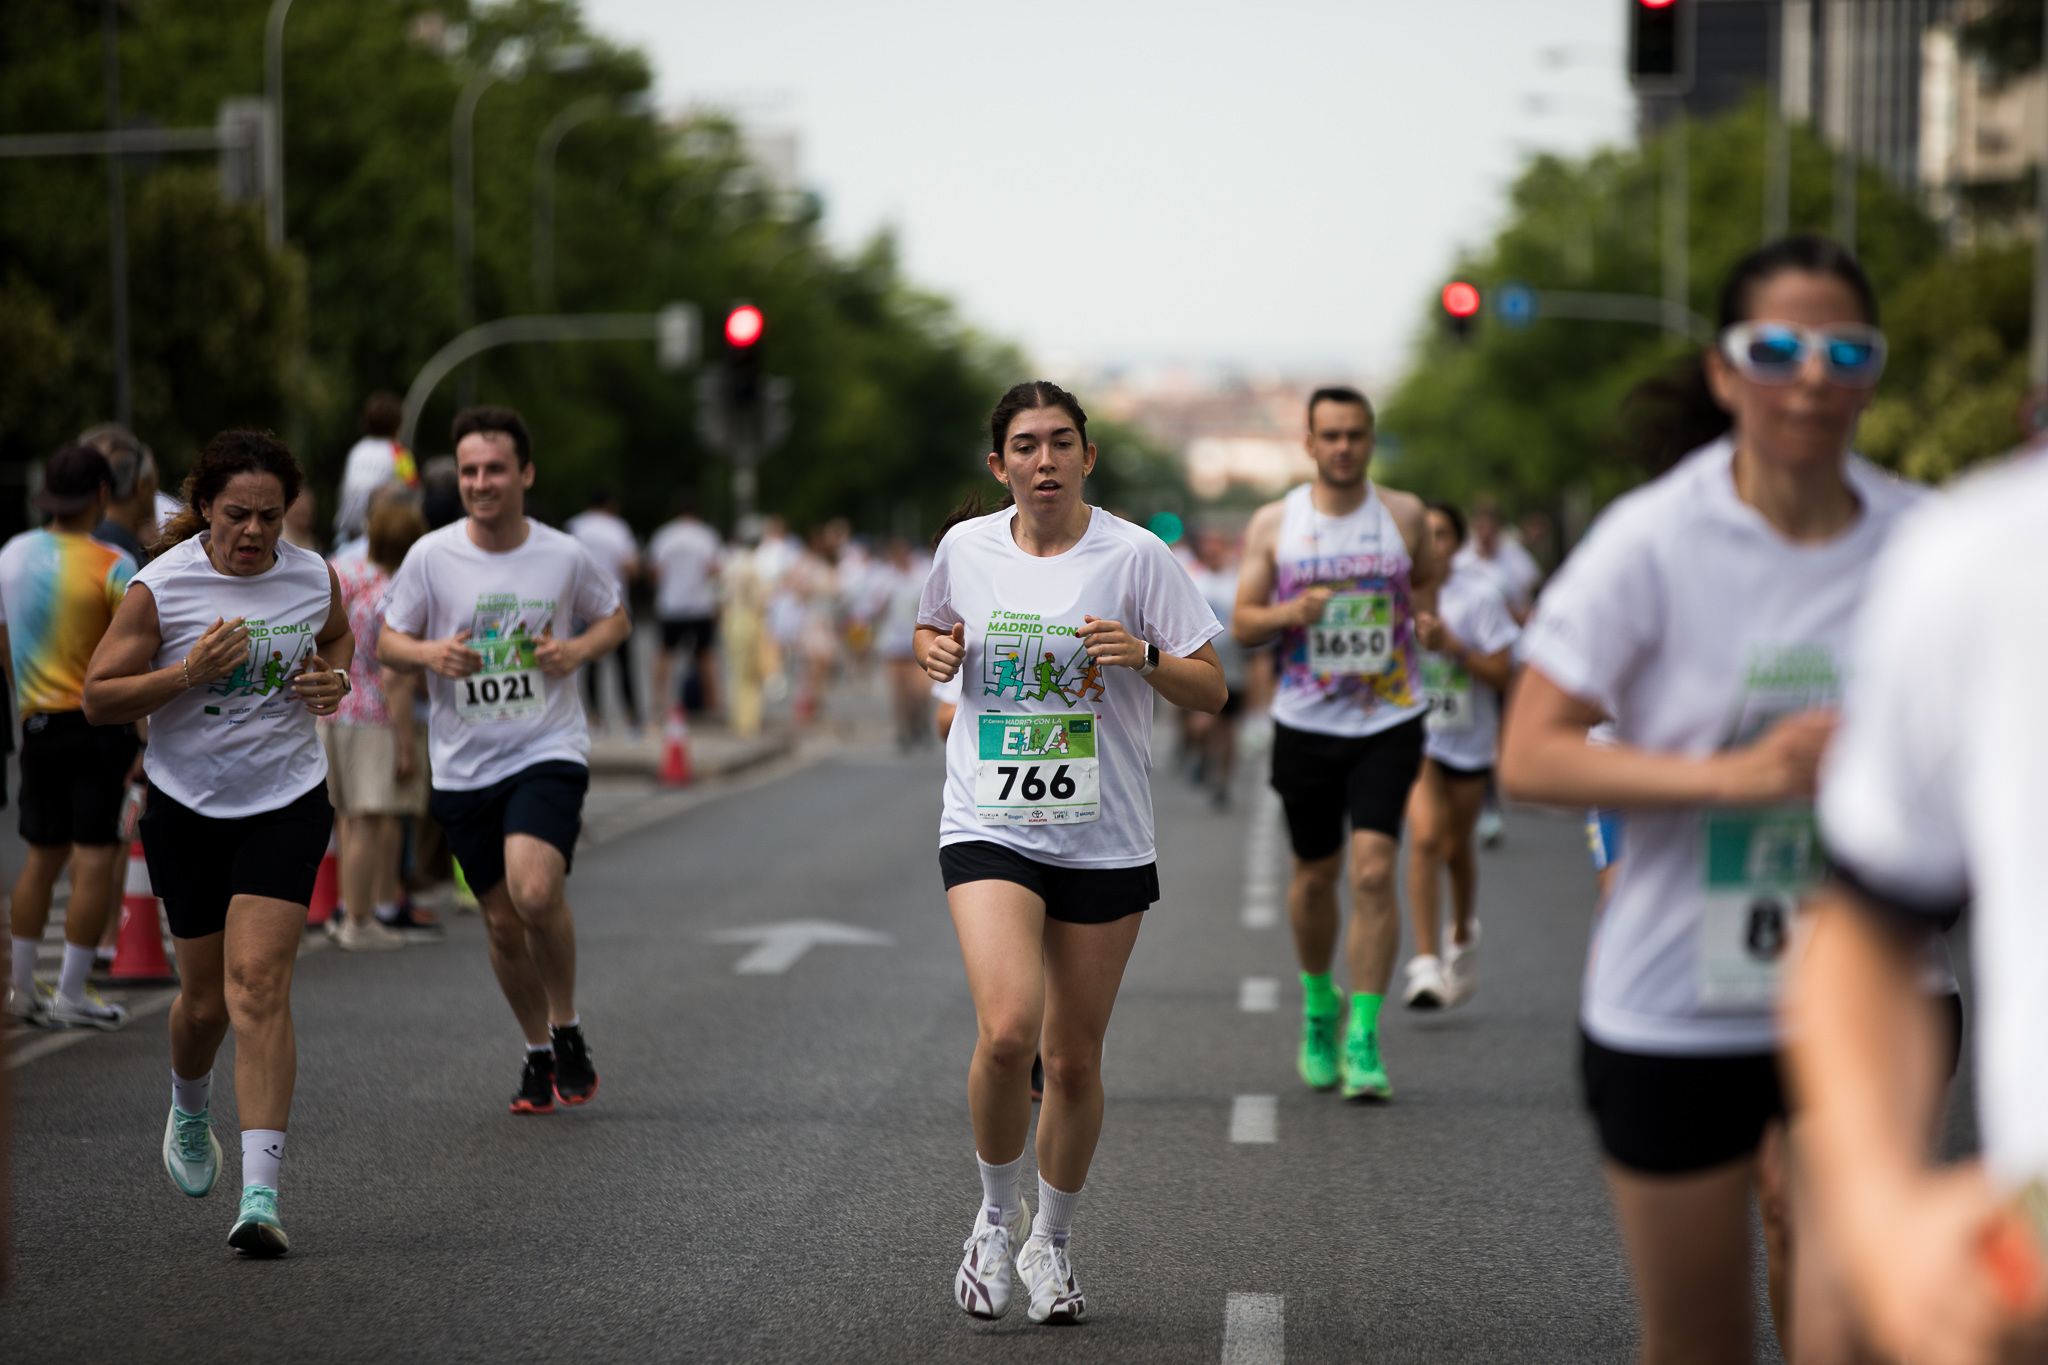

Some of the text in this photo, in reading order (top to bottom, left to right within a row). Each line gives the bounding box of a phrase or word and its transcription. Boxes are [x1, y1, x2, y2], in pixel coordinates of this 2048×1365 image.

[1003, 611, 1041, 621] Carrera
[247, 623, 311, 638] RID CON LA
[987, 621, 1079, 636] MADRID CON
[1315, 630, 1386, 658] 1650
[466, 673, 534, 705] 1021
[1005, 718, 1032, 726] MADRID
[1001, 724, 1069, 756] ELA
[997, 764, 1076, 801] 766
